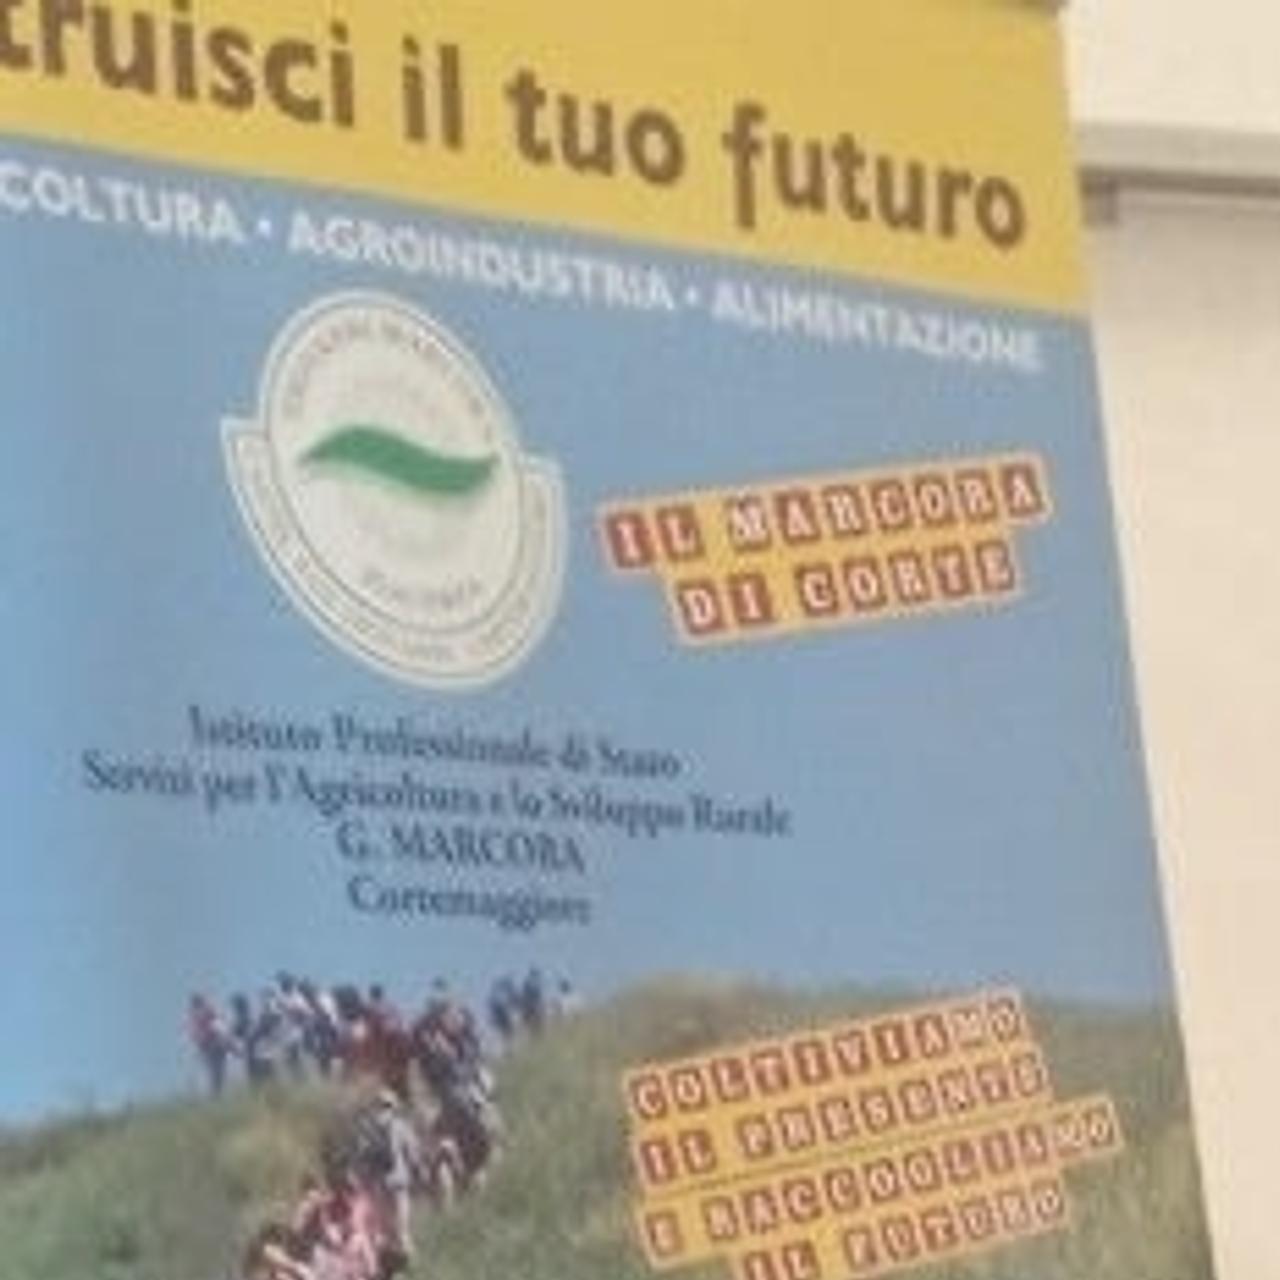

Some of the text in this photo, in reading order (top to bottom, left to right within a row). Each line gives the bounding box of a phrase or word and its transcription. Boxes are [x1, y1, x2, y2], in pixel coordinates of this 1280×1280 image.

[401, 36, 465, 150] il
[504, 68, 686, 187] tuo
[722, 102, 1026, 250] futuro
[287, 210, 676, 311] AGROINDUSTRIA
[710, 280, 1042, 372] ALIMENTAZIONE
[609, 465, 1041, 567] IL MARCORA
[679, 541, 1015, 635] DI CORTE
[633, 1001, 1019, 1120] COLTIVIAMO
[641, 1053, 1048, 1184] IL PRESENTE
[843, 1180, 1064, 1269] FUTURO
